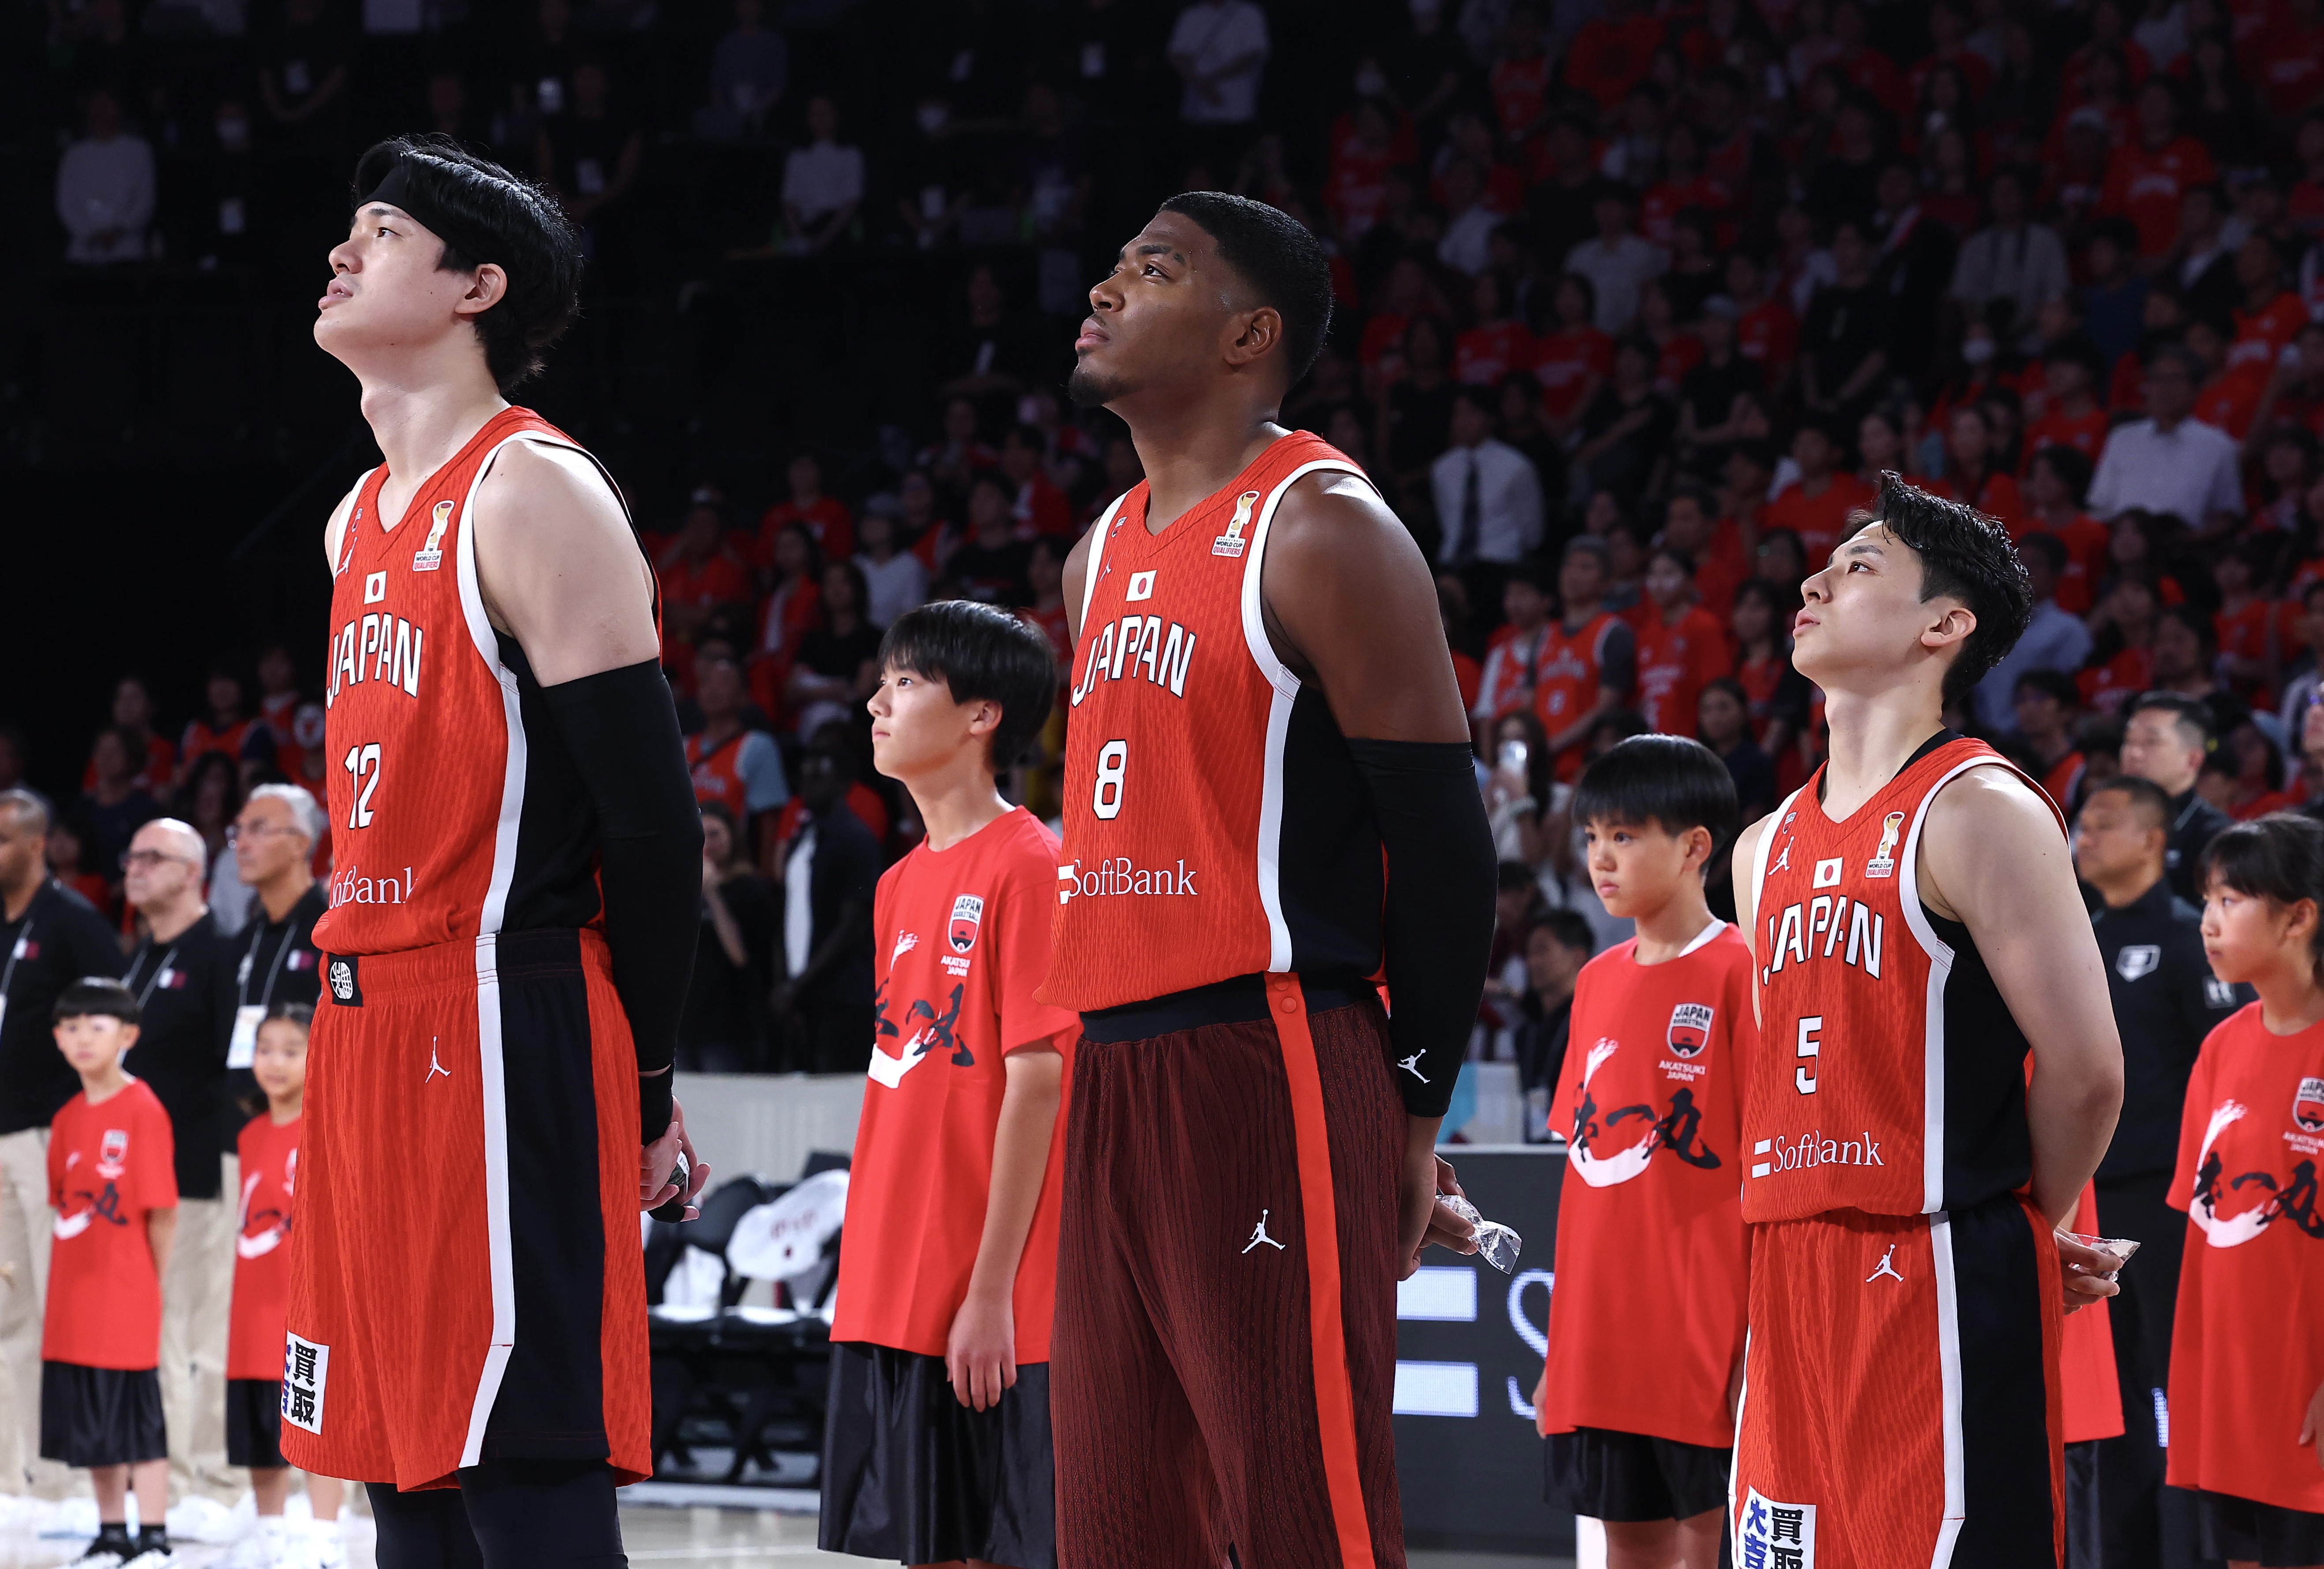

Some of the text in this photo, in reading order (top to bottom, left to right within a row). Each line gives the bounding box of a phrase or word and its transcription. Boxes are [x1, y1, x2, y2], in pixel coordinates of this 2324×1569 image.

[1213, 546, 1241, 555] QUALIFIERS
[326, 612, 423, 710] JAPAN
[1071, 614, 1197, 708] JAPAN
[343, 742, 381, 829] 12
[1092, 739, 1128, 820] 8
[955, 898, 981, 914] JAPAN
[1069, 857, 1198, 897] SoftBank
[947, 965, 968, 978] JAPAN
[1676, 1006, 1711, 1021] JAPAN
[1658, 1060, 1706, 1076] AKATSUKI
[1795, 1014, 1823, 1095] 5
[1773, 1129, 1885, 1172] SoftBank
[291, 1341, 318, 1427] 買取
[1744, 1496, 1768, 1569] 大吉
[1770, 1506, 1804, 1569] 買取
